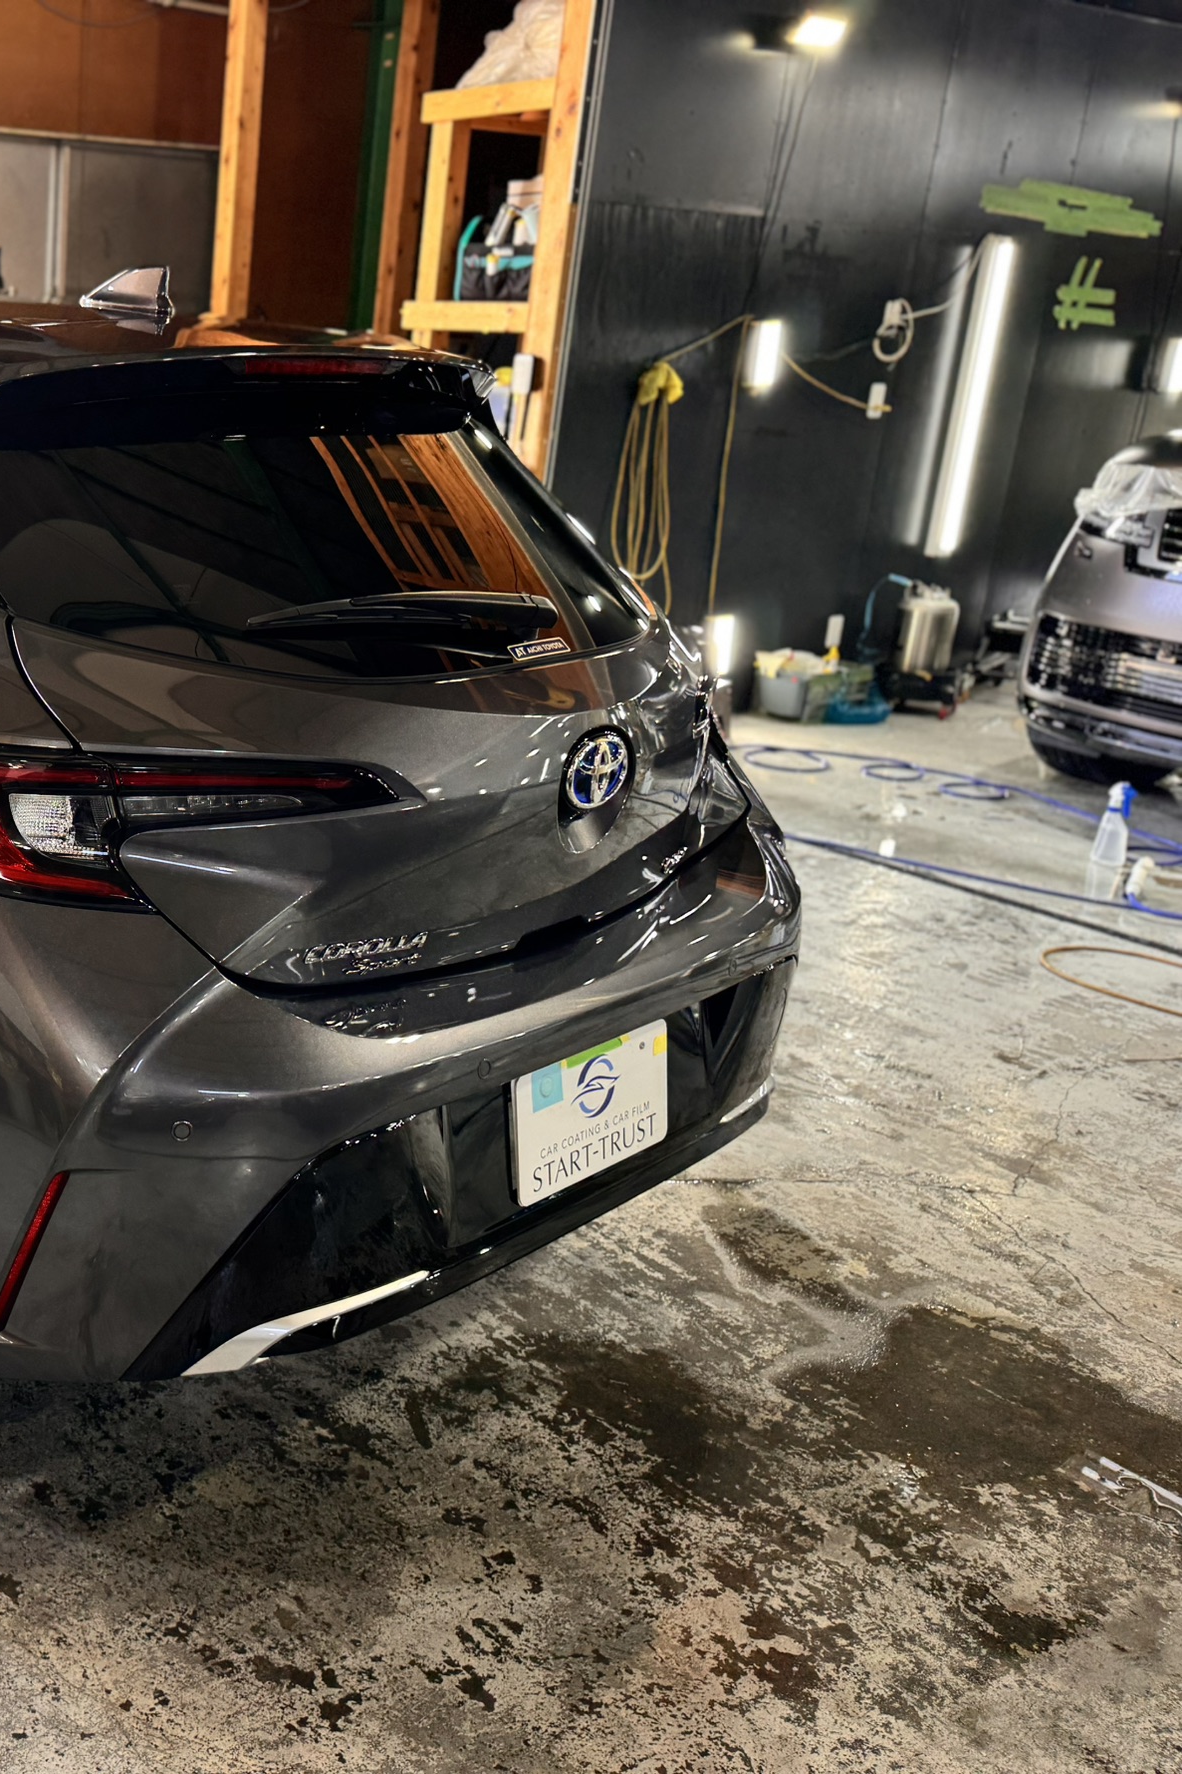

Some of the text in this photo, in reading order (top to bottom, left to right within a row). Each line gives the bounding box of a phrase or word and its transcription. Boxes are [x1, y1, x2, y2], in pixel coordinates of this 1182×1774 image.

[304, 931, 428, 964] COROLLA
[533, 1113, 657, 1193] START-TRUST
[540, 1101, 650, 1159] CAR COATING & CAR FILM
